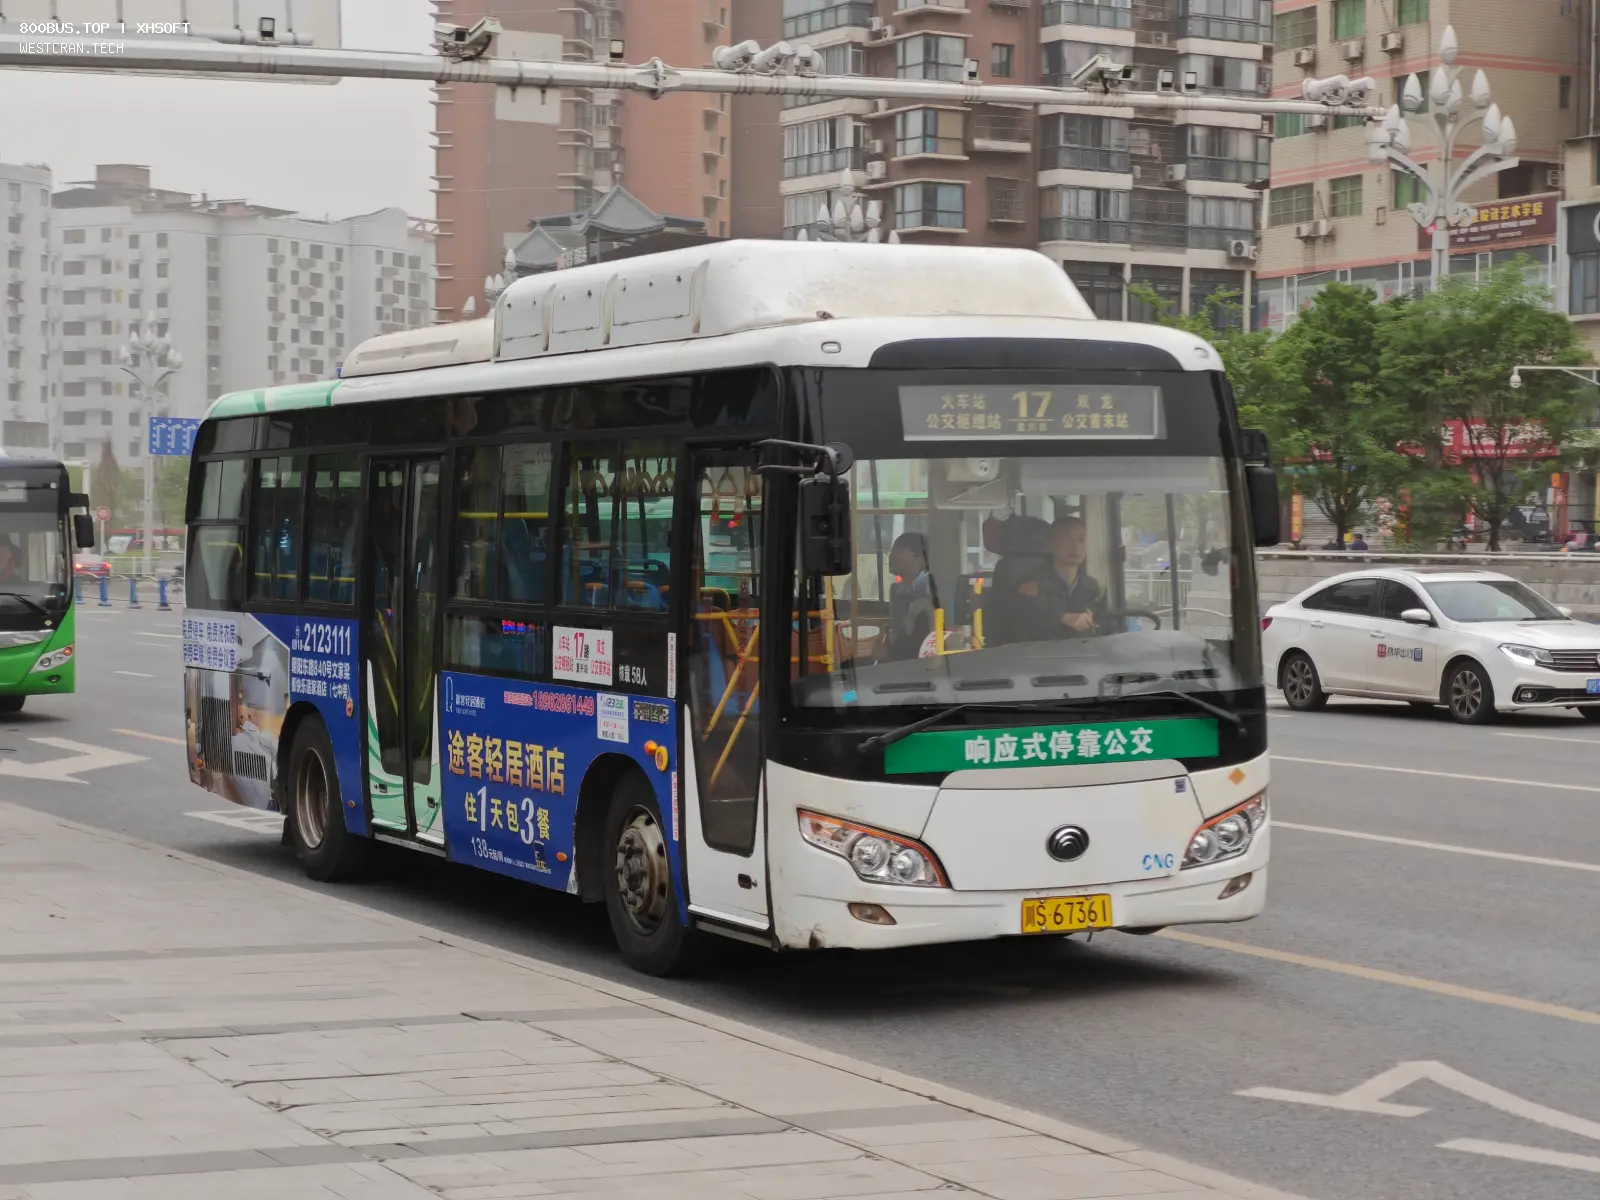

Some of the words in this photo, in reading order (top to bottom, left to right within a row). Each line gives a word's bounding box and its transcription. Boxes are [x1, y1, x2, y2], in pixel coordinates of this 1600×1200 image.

[941, 394, 986, 410] 火车站
[1012, 391, 1053, 418] 17
[964, 727, 1154, 763] 响应式停靠公交
[448, 730, 565, 796] 途客轻居酒店
[1142, 853, 1174, 870] CNG
